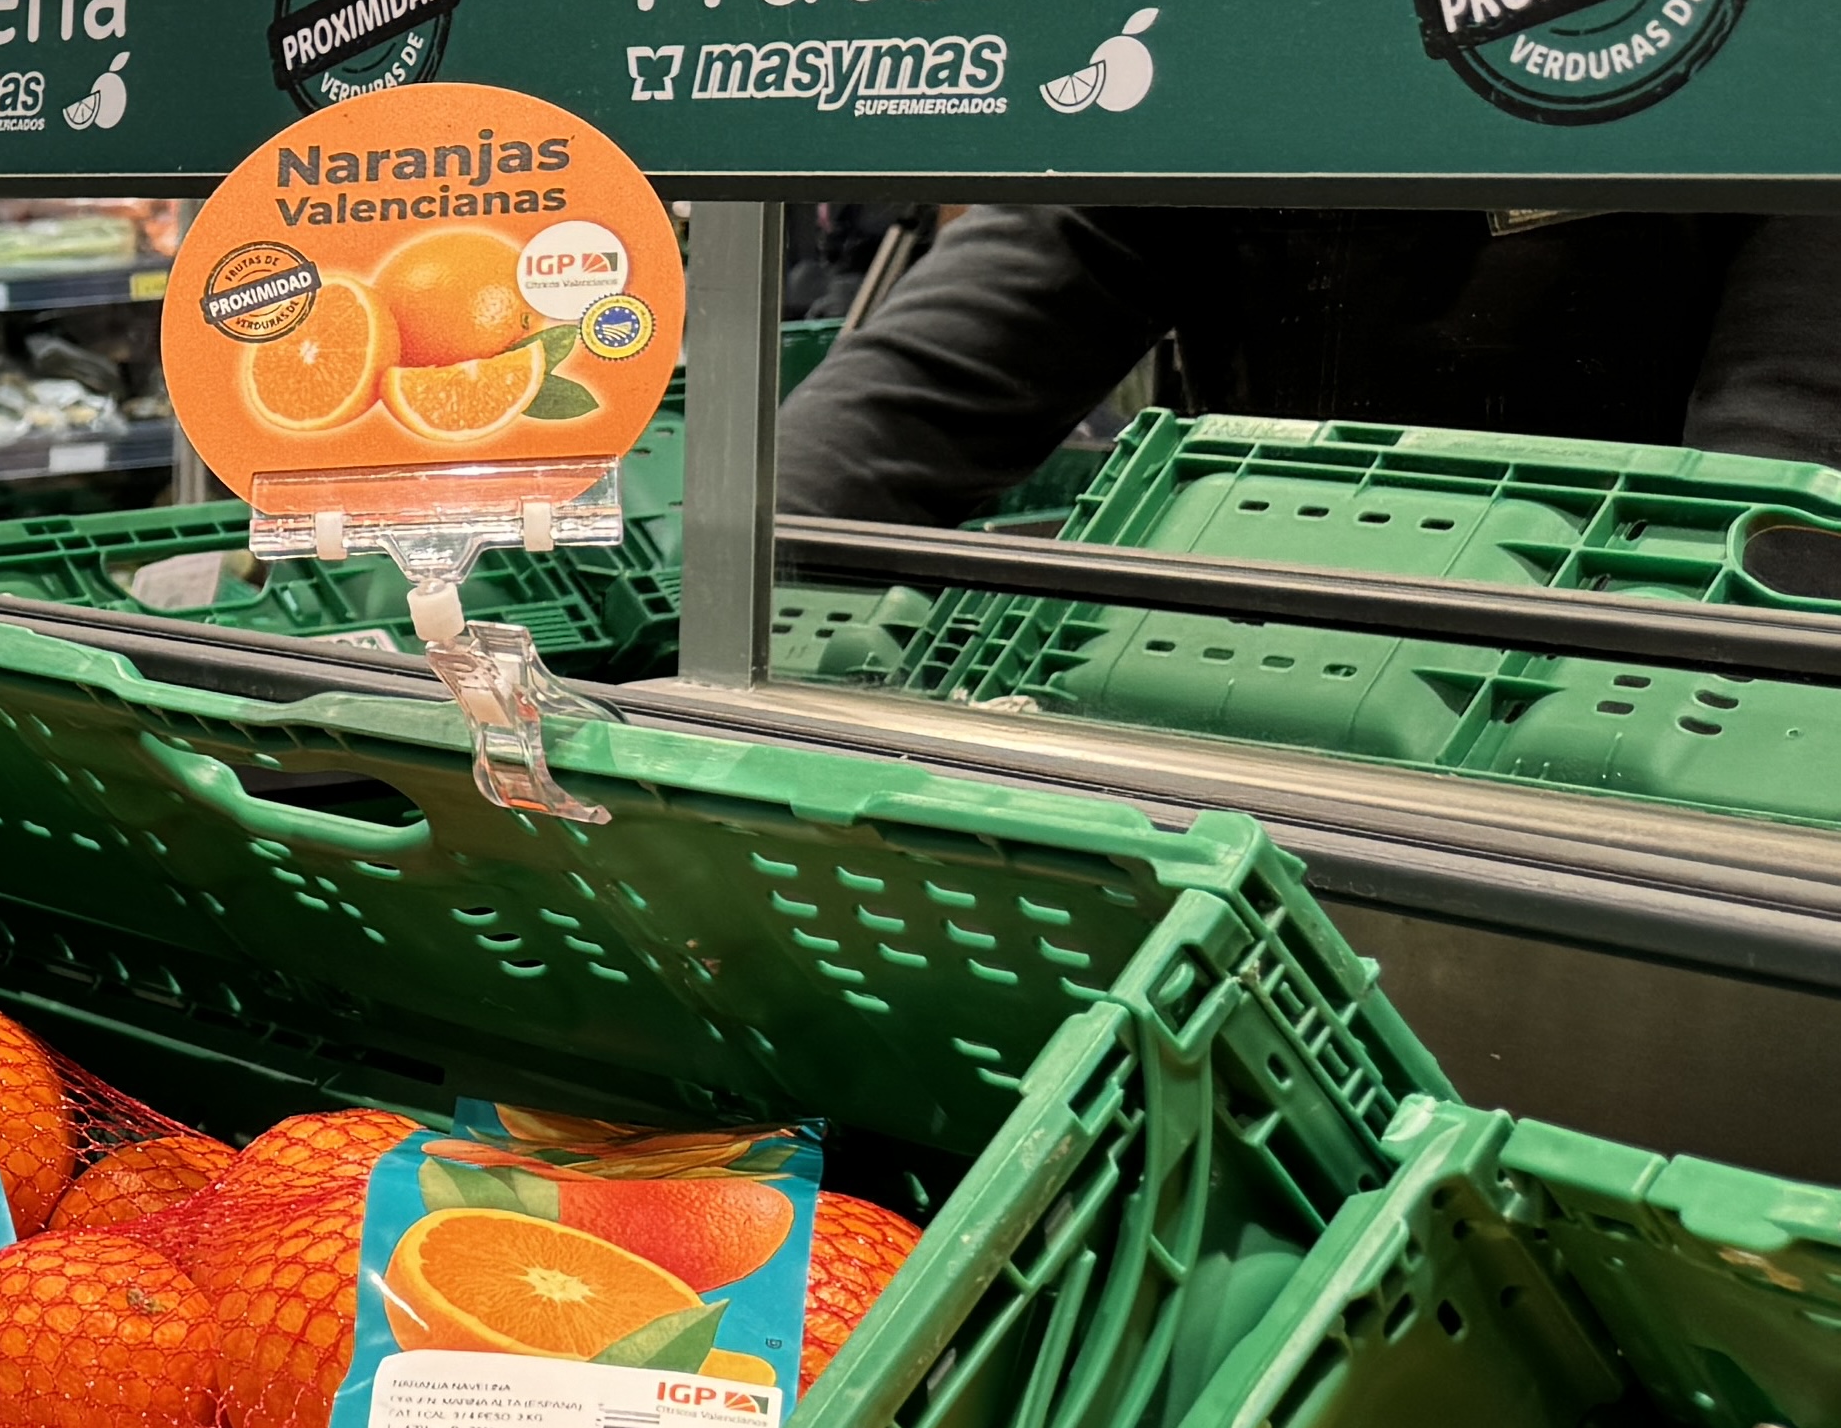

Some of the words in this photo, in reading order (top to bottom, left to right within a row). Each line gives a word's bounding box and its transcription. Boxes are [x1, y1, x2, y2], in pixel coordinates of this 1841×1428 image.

[401, 32, 424, 66] DE
[1508, 12, 1675, 83] VERDURAS
[692, 34, 1008, 111] masymas
[853, 96, 1009, 117] SUPERMERCADOS
[275, 129, 571, 189] Naranjas
[275, 184, 568, 227] Valencianas
[225, 255, 262, 282] FRUTAS
[265, 255, 280, 266] DE
[526, 254, 576, 277] IGP
[209, 271, 312, 317] PROXIMIDAD
[235, 311, 290, 330] VERDURAS
[286, 300, 300, 313] DE
[657, 1382, 717, 1405] IGP
